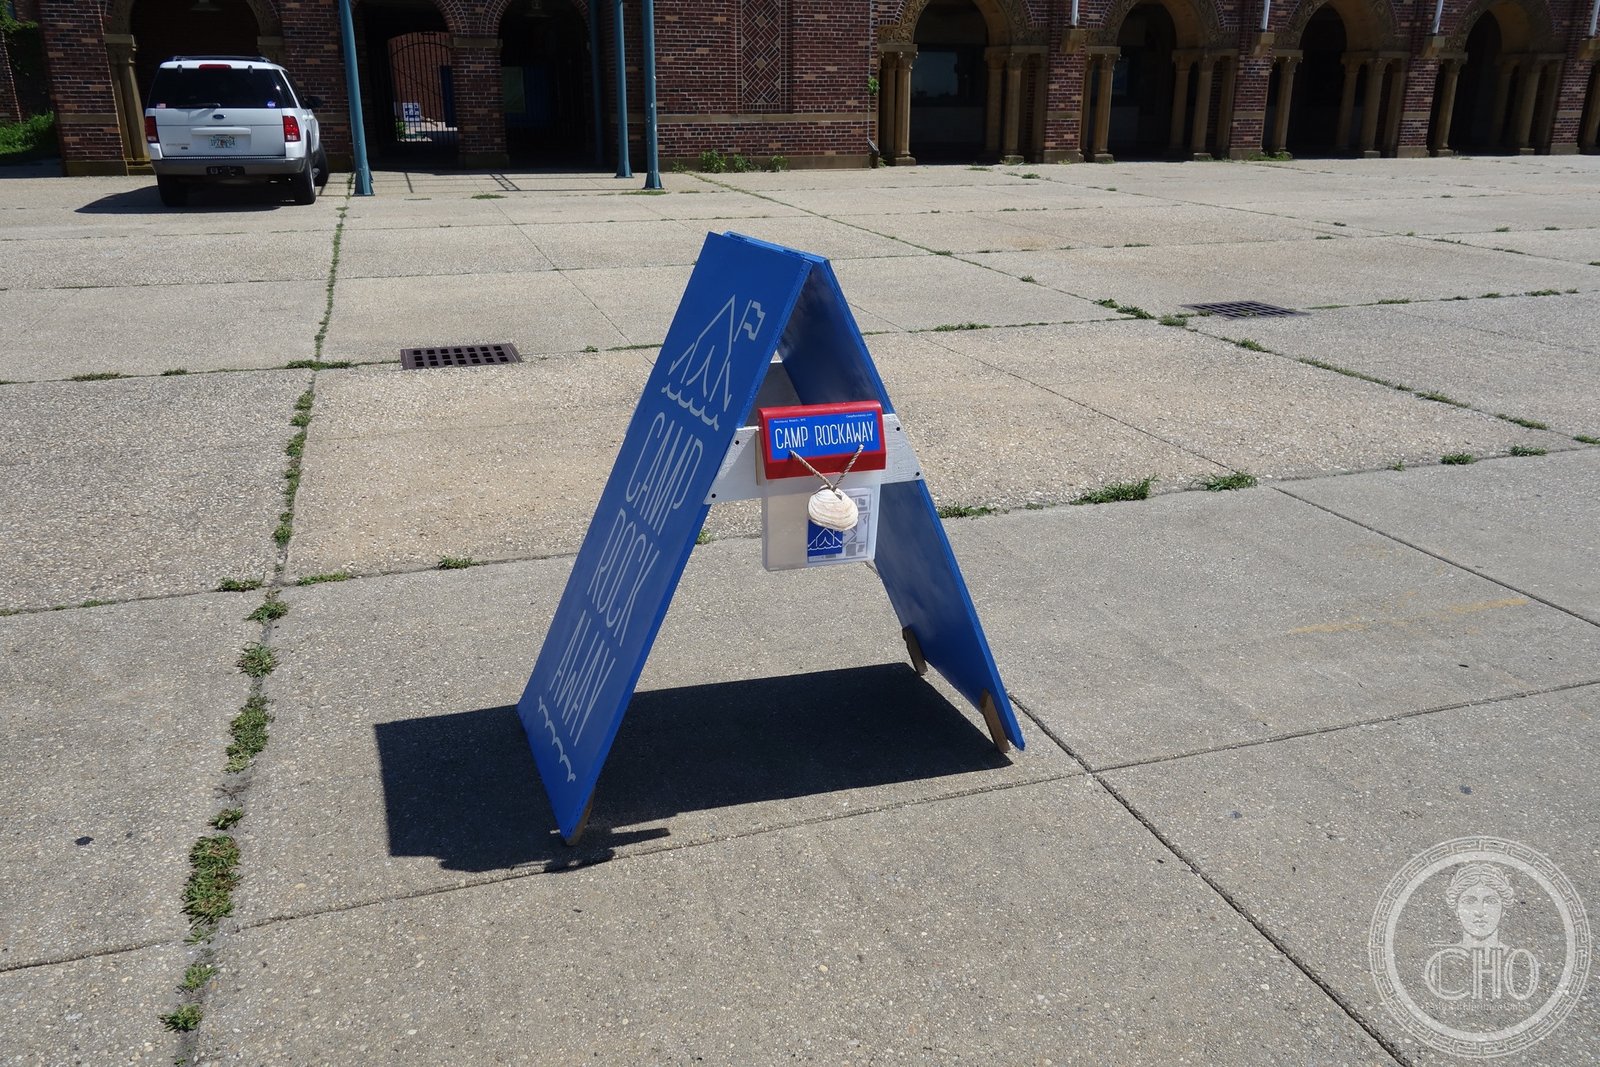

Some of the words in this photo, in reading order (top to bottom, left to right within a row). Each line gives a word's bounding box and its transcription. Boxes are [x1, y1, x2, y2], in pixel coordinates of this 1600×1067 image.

[626, 411, 704, 537] CAMP
[774, 426, 809, 450] CAMP
[814, 421, 874, 447] ROCKAWAY
[586, 507, 662, 648] ROCK
[548, 609, 617, 748] AWAY
